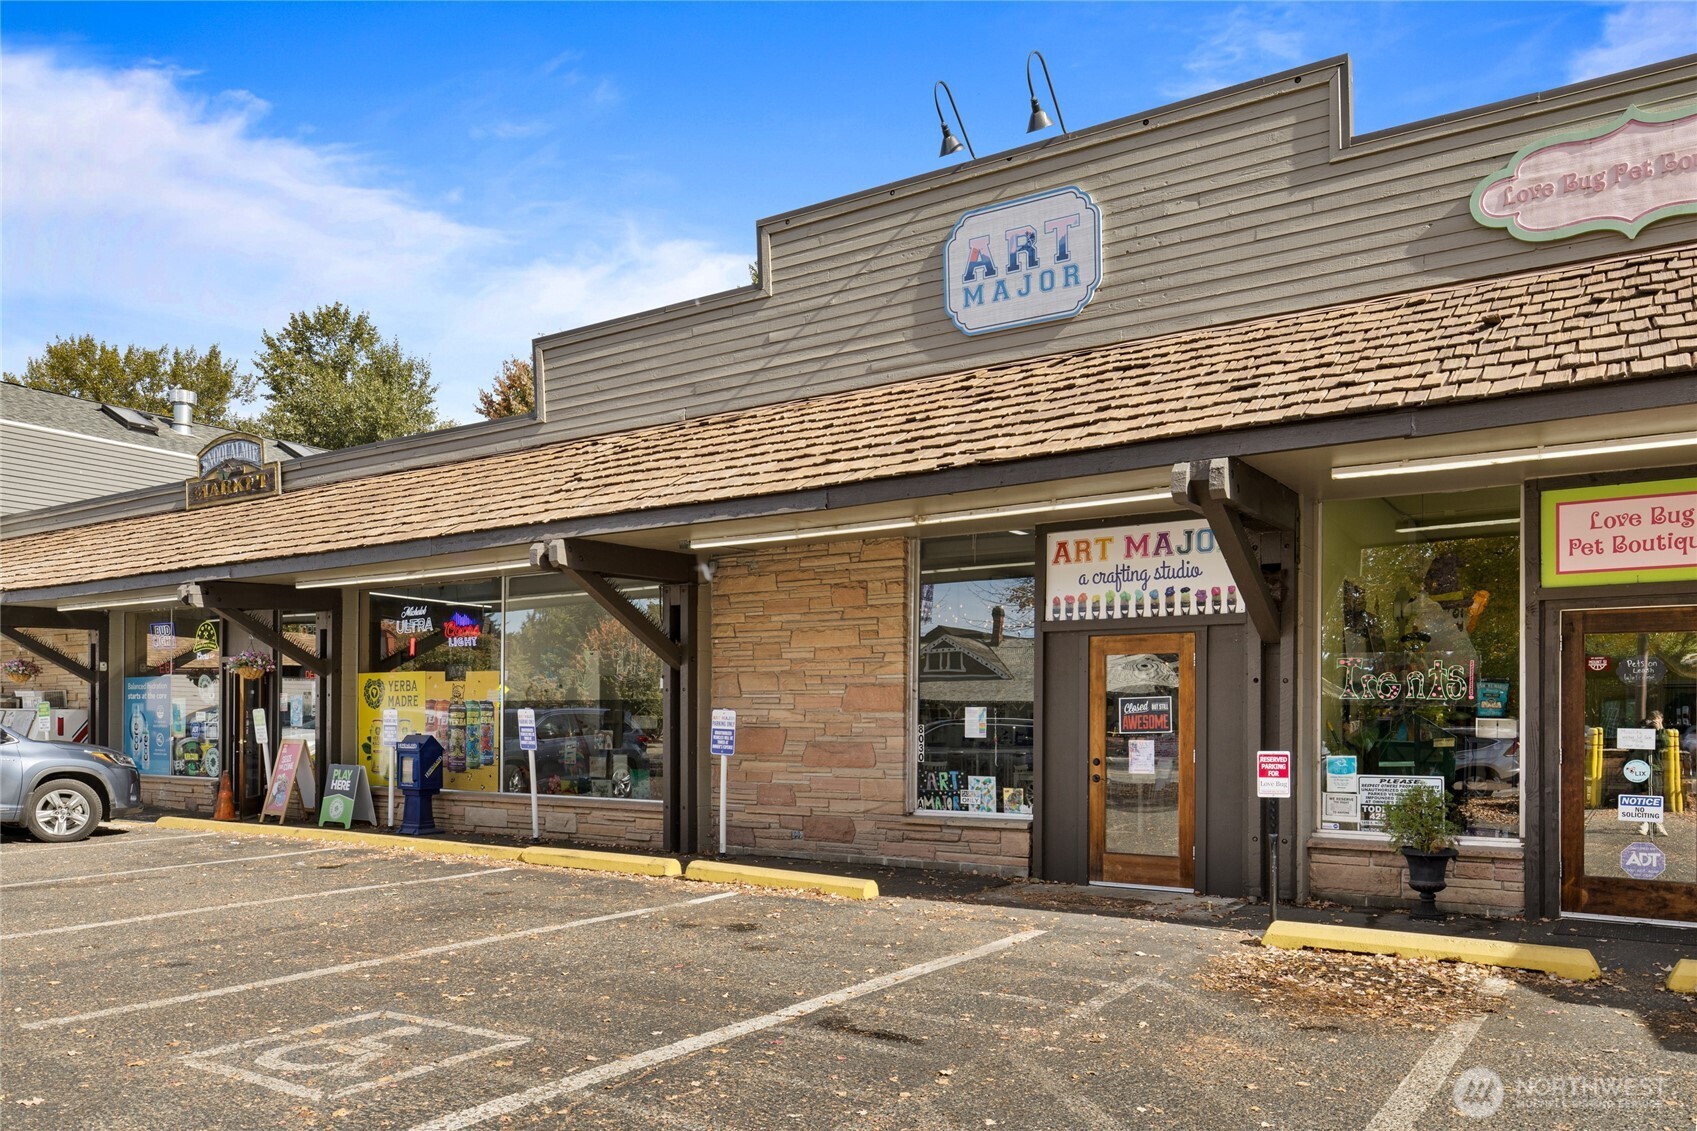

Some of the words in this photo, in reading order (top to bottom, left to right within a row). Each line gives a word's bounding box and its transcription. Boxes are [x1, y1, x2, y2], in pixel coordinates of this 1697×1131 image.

[1503, 181, 1556, 207] Love
[1562, 171, 1607, 193] Bug
[1614, 159, 1654, 184] Pet
[961, 212, 1081, 284] ART
[962, 263, 1081, 309] MAJOR
[1589, 510, 1642, 530] Love
[1651, 505, 1695, 528] Bug
[1052, 536, 1115, 566] ART
[1123, 527, 1221, 560] MAJO
[1568, 538, 1605, 556] Pet
[1078, 573, 1090, 586] a
[1092, 563, 1151, 593] crafting
[1153, 559, 1203, 580] studio
[154, 625, 171, 636] BUD
[395, 617, 434, 635] ULTRA
[443, 621, 481, 638] Coors
[448, 636, 478, 647] LIGHT
[1626, 660, 1644, 668] Pets
[388, 679, 418, 692] YERBA
[387, 694, 419, 708] MADRE
[1124, 700, 1150, 714] Closed
[1122, 714, 1169, 730] AWESOME
[332, 768, 353, 780] PLAY
[927, 771, 958, 791] ART
[330, 780, 351, 791] HERE
[924, 795, 960, 811] MAJOR
[1621, 797, 1660, 806] NOTICE
[1626, 850, 1660, 867] ADT
